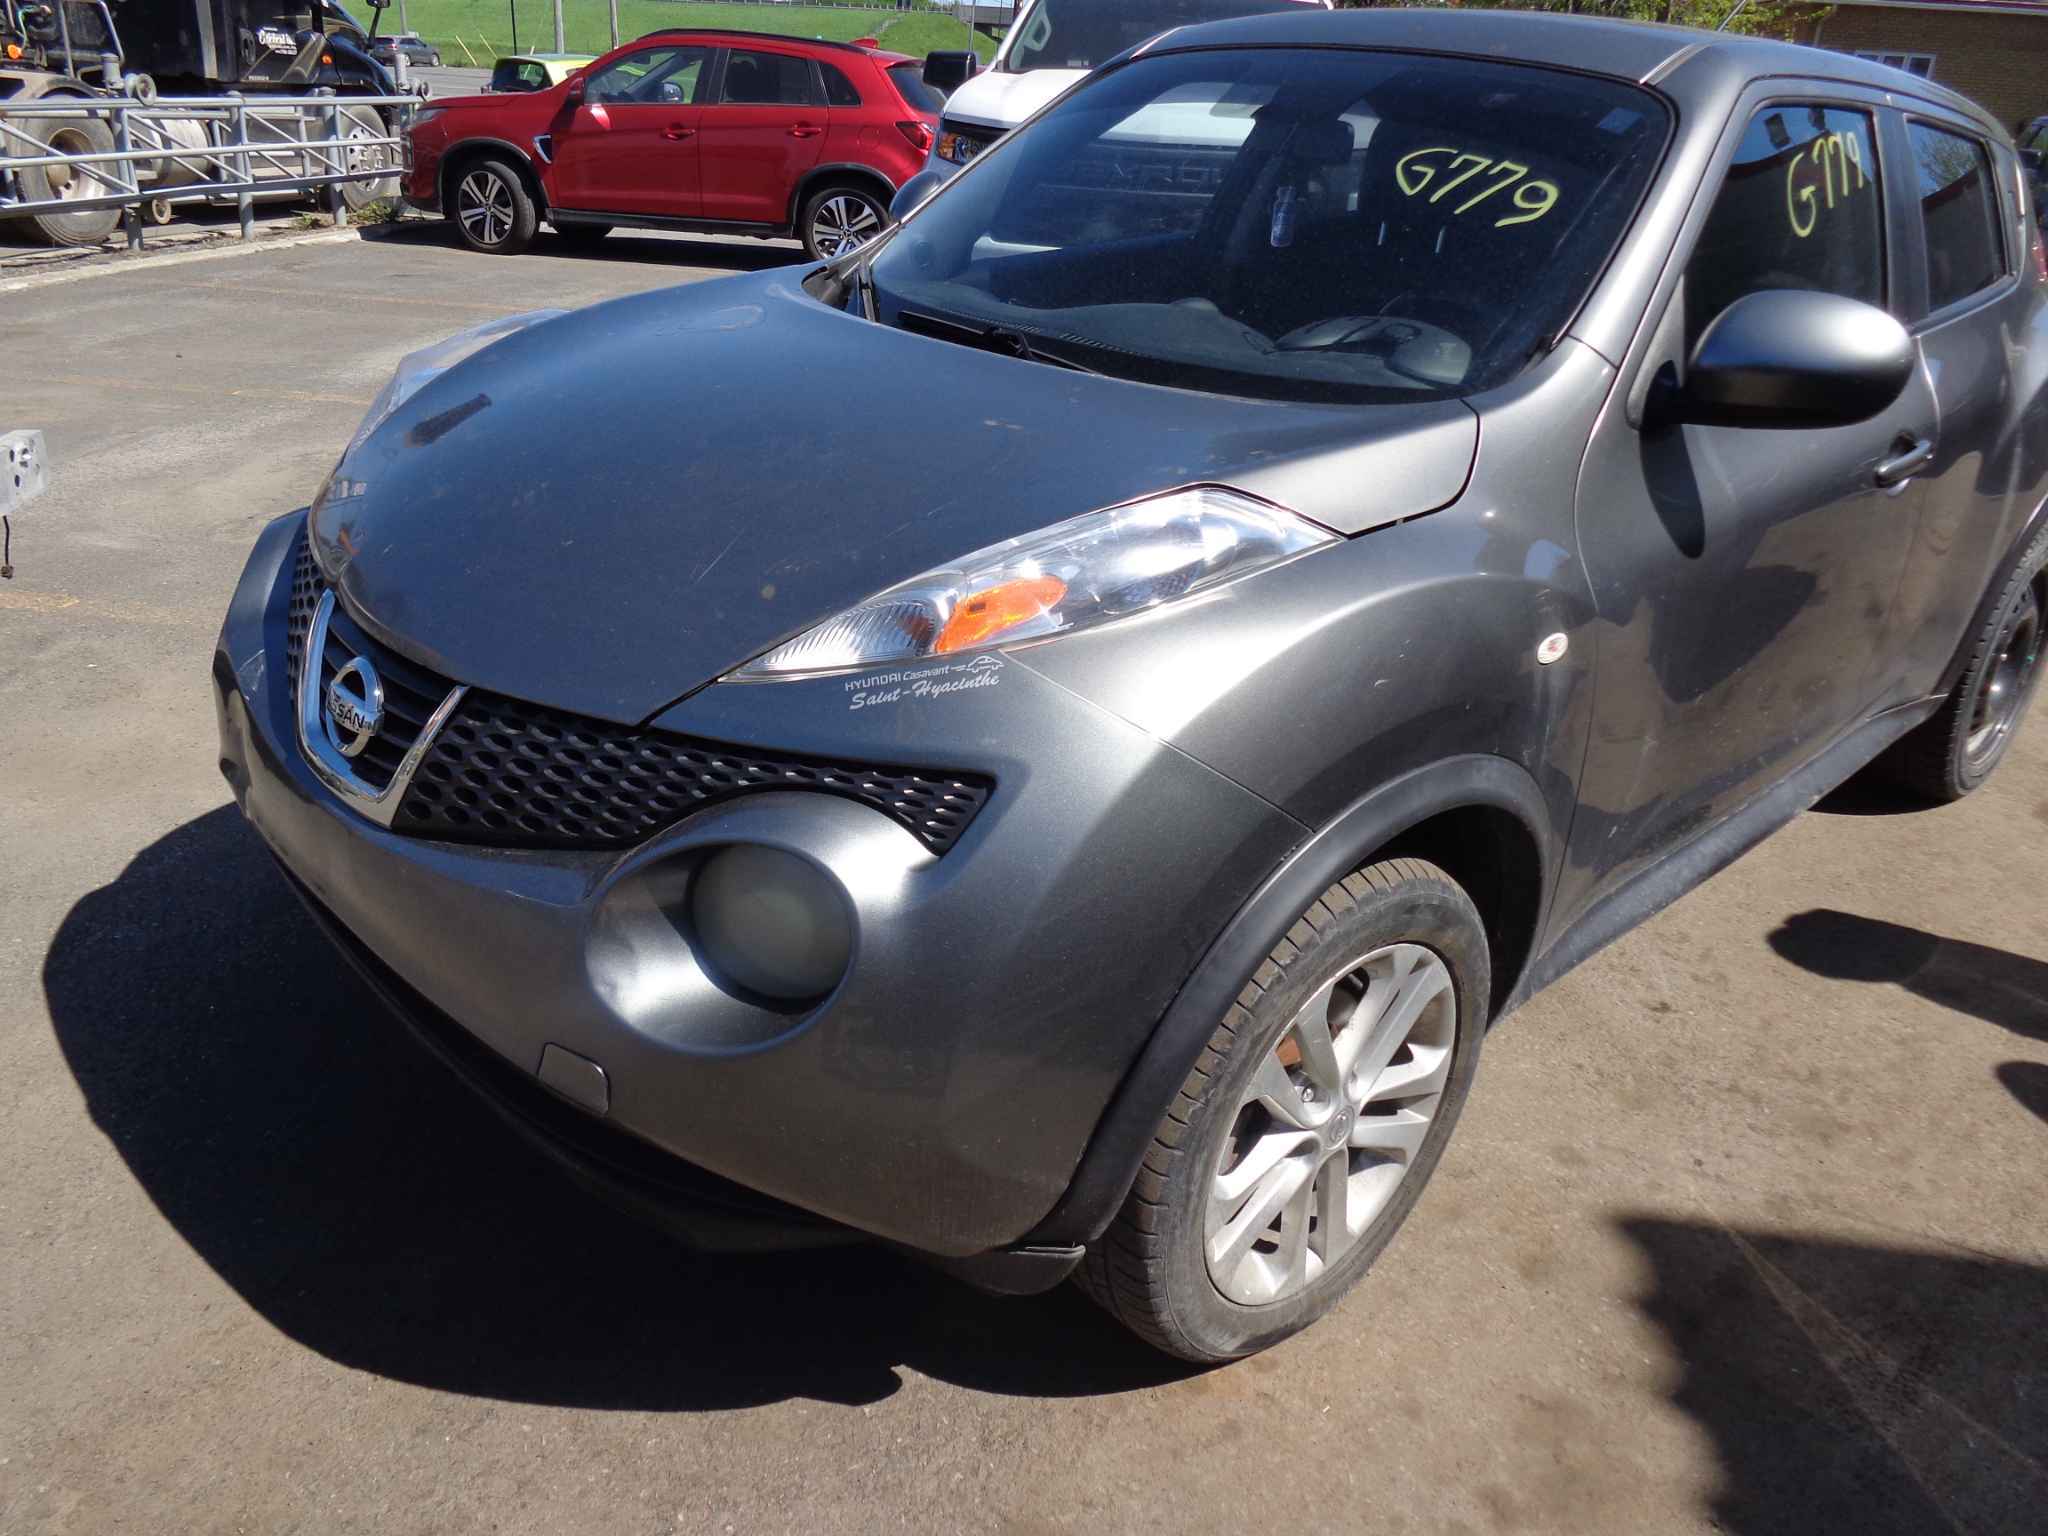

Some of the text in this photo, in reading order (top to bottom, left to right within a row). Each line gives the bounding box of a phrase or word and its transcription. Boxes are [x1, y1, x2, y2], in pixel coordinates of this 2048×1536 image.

[1395, 147, 1560, 228] G779
[1786, 131, 1864, 238] G779
[844, 665, 950, 692] HYUNDAI Casavant
